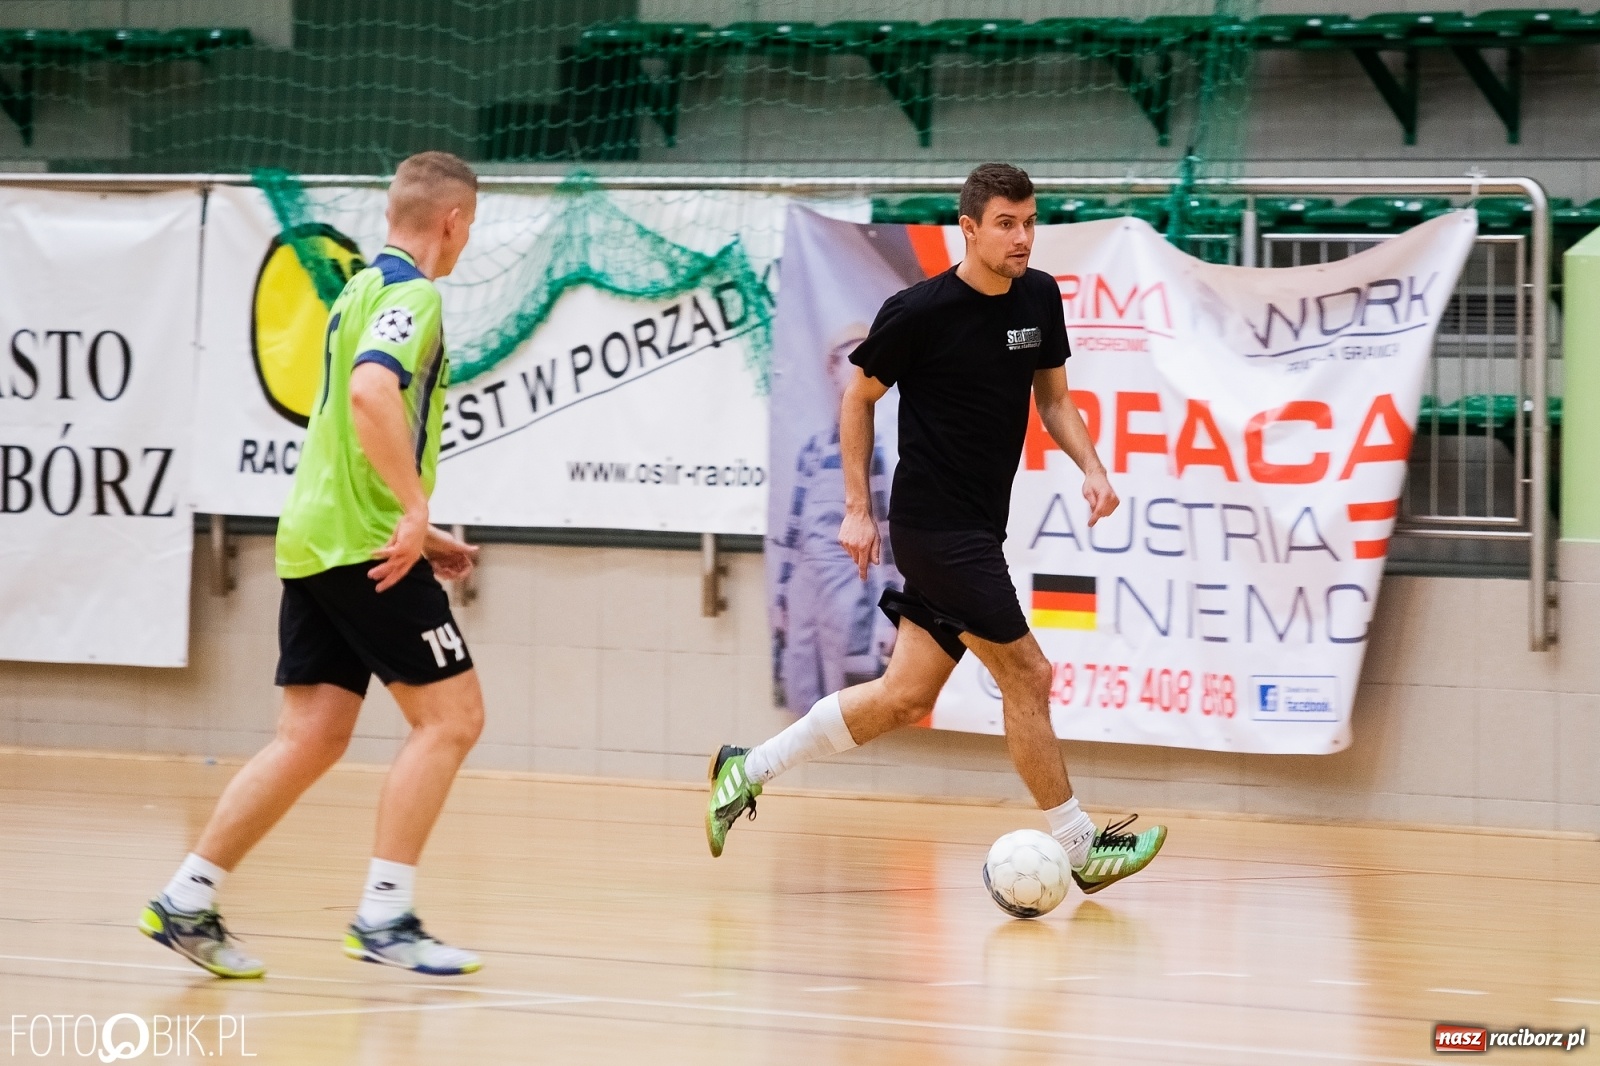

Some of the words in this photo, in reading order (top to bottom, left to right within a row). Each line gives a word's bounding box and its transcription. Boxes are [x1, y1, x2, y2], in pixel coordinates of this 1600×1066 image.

[1246, 271, 1439, 349] WORK
[0, 328, 132, 402] STO
[520, 358, 556, 413] W
[0, 423, 175, 518] BÓRZ
[238, 438, 304, 475] RAC
[1029, 493, 1341, 563] AUSTRIA
[421, 622, 466, 668] 14
[1082, 663, 1130, 709] 735
[1139, 667, 1192, 714] 408
